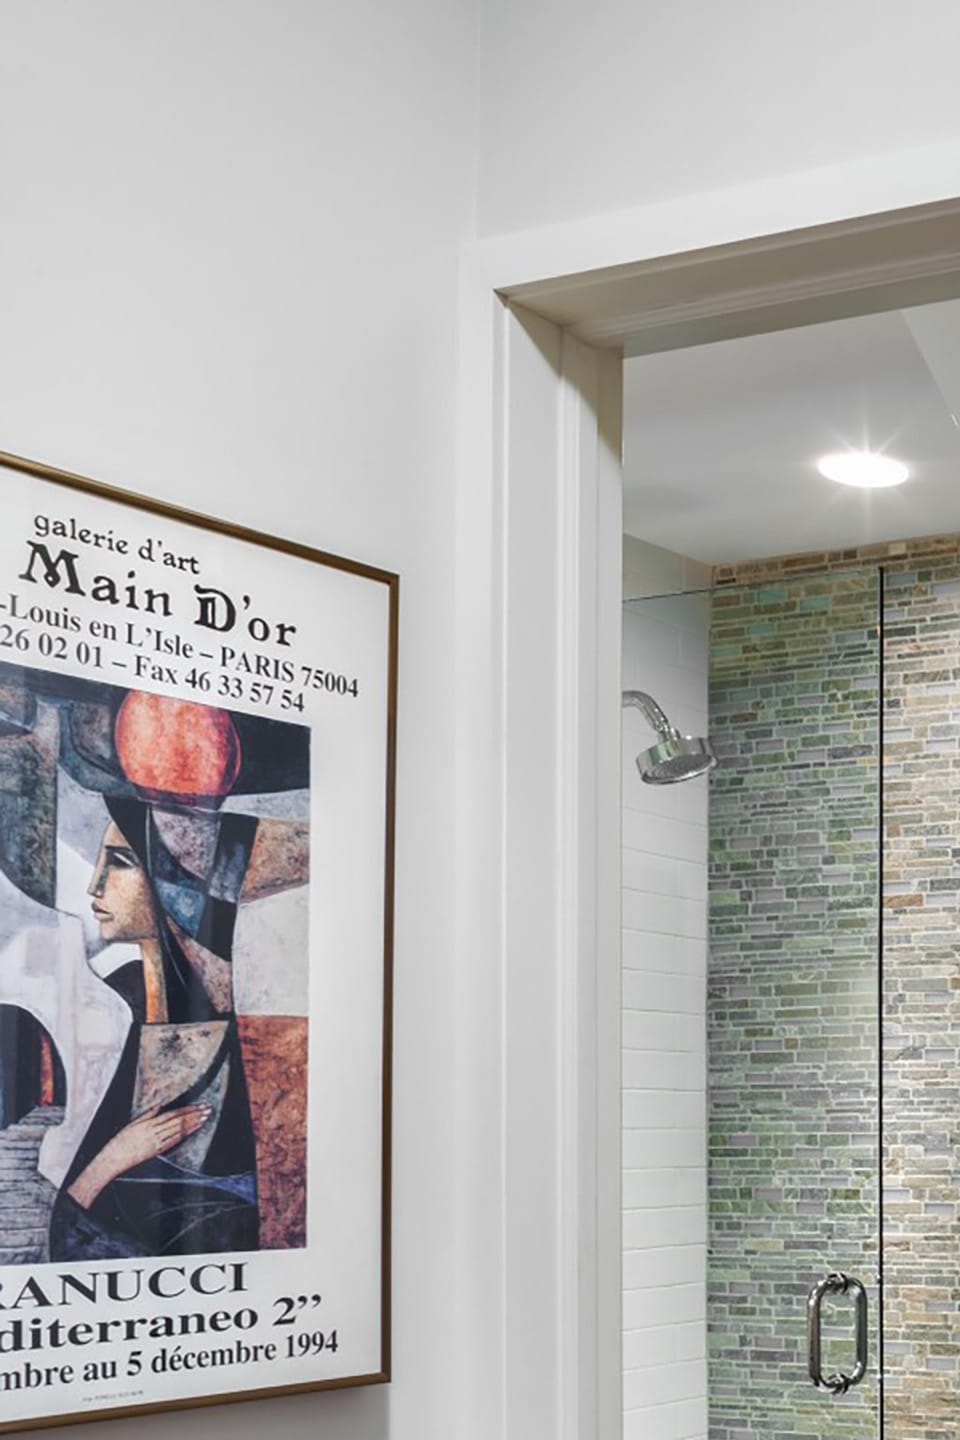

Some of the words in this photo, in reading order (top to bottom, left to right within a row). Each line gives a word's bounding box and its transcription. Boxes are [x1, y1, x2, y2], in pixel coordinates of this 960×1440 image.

[34, 514, 129, 555] galerie
[138, 538, 200, 575] d'art
[18, 540, 173, 617] Main
[193, 583, 297, 647] D'or
[0, 624, 30, 652] 26
[38, 632, 68, 660] 02
[76, 640, 104, 669] 01
[134, 654, 178, 685] Fax
[184, 667, 211, 692] 46
[217, 674, 243, 700] 33
[249, 682, 274, 706] 57
[280, 688, 304, 713] 54
[89, 619, 117, 641] en
[126, 622, 194, 659] L'Isle
[221, 646, 295, 683] PARIS
[301, 665, 359, 698] 75004
[0, 1262, 249, 1310] ANUCCI
[0, 1308, 259, 1352] diterraneo
[83, 1360, 117, 1382] au
[127, 1350, 143, 1377] 5
[151, 1338, 277, 1373] décembre
[286, 1329, 339, 1359] 1994
